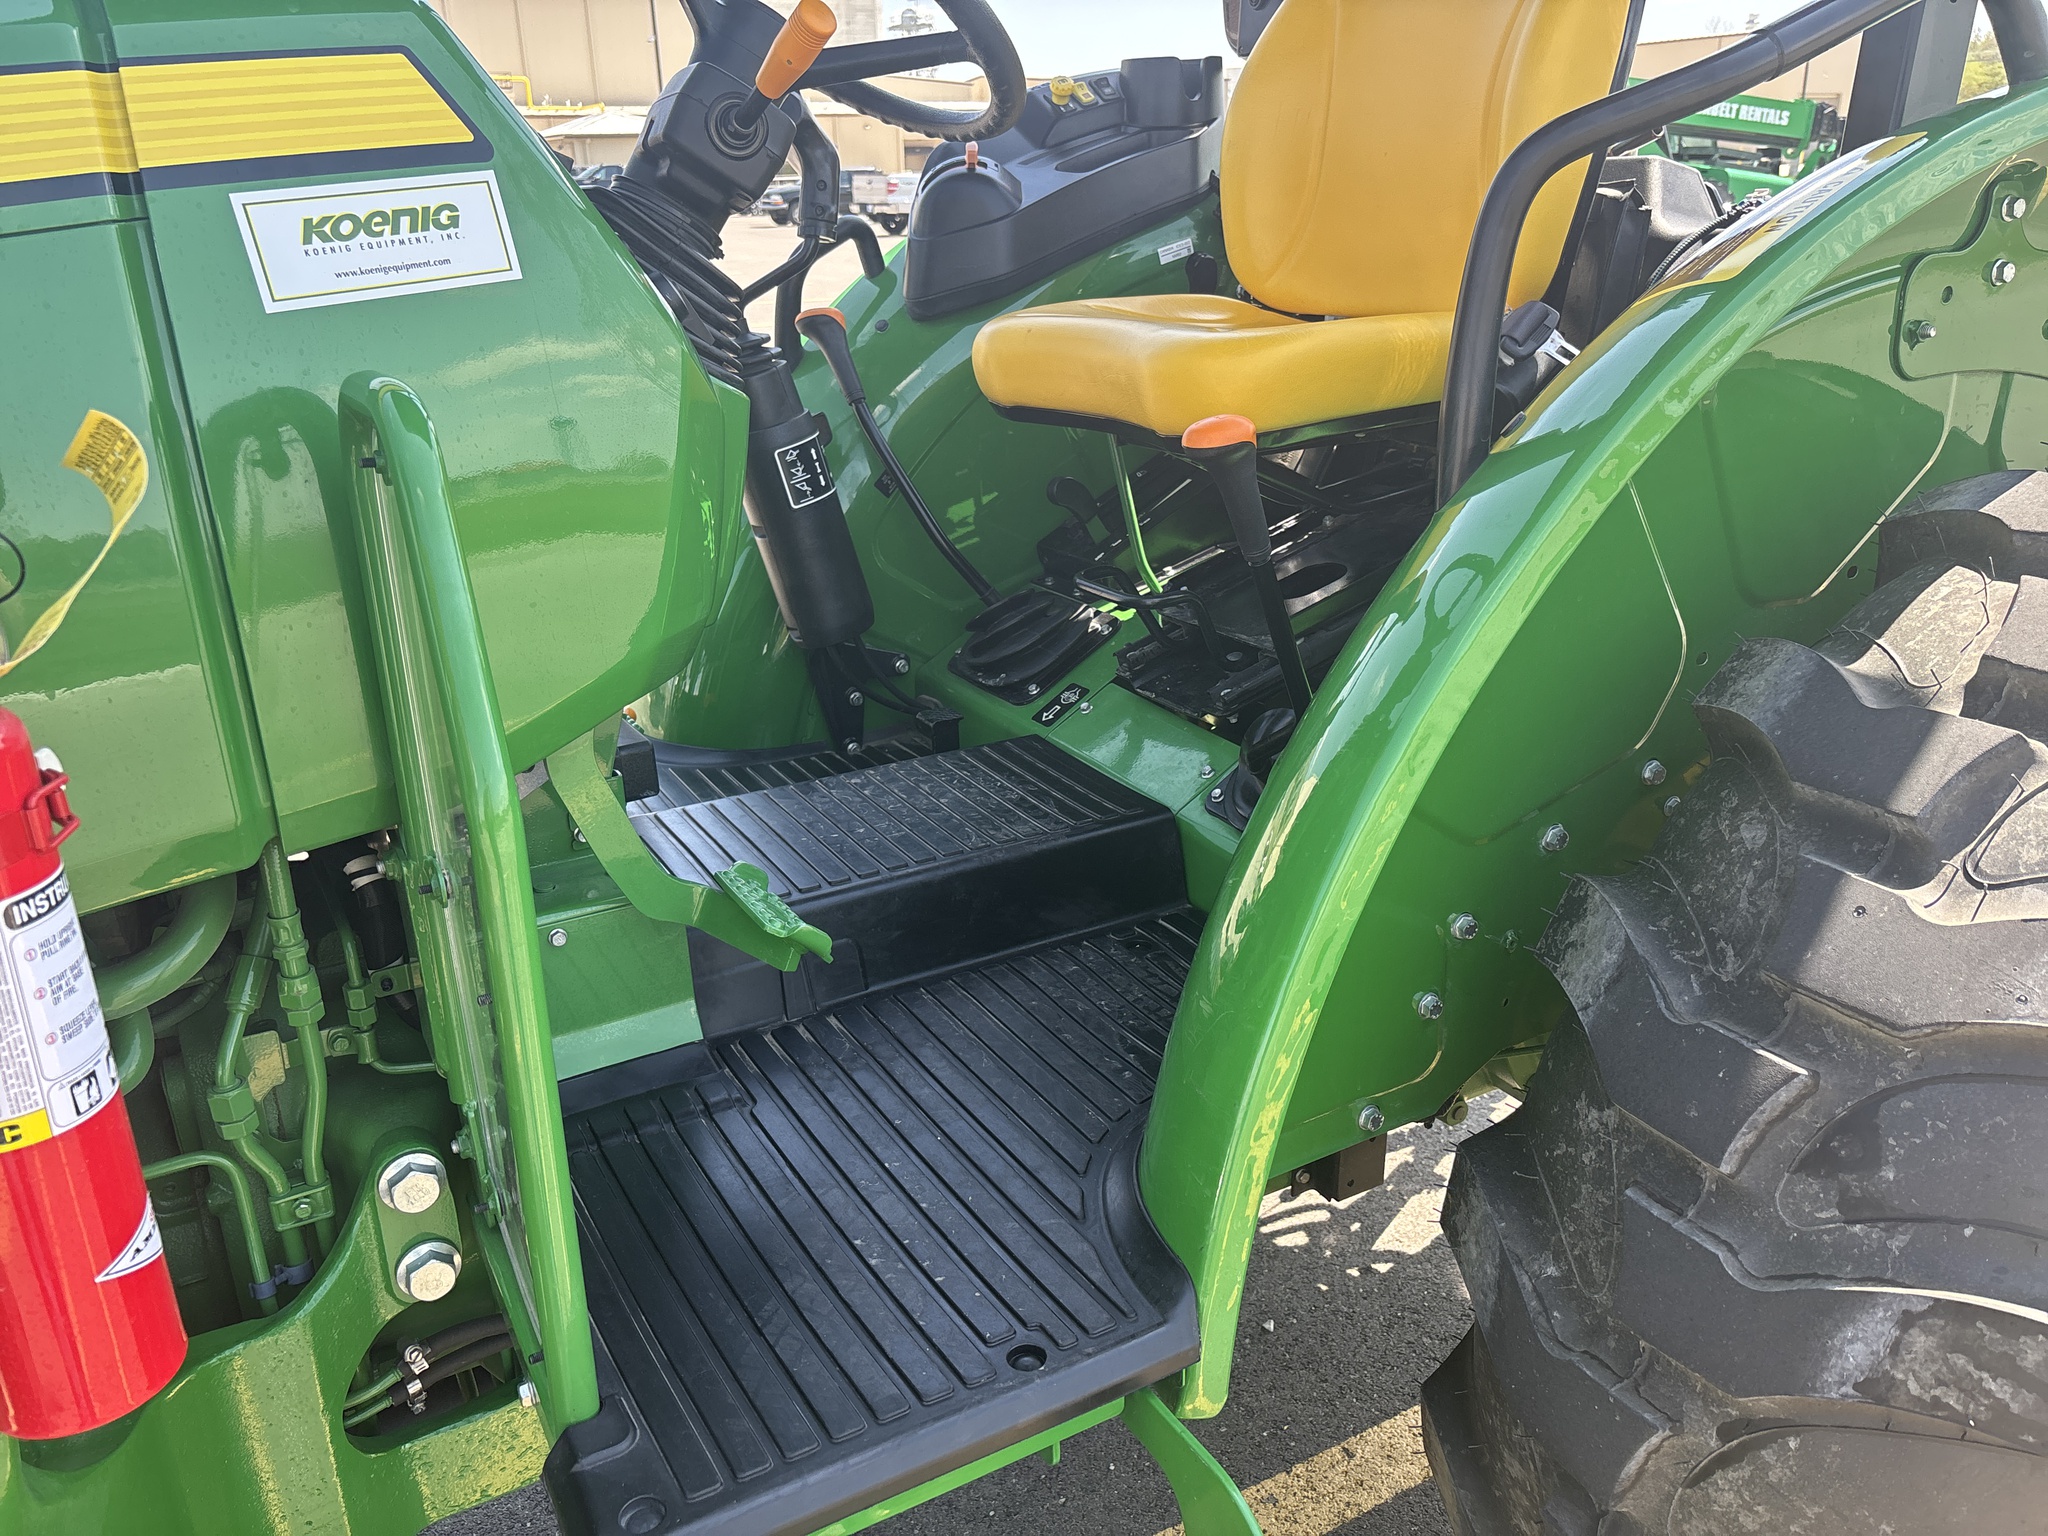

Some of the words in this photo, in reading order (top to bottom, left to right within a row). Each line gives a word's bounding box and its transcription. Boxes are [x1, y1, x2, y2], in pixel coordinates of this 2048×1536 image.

[1706, 102, 1739, 119] BELT
[1738, 104, 1790, 126] RENTALS
[1763, 180, 1844, 233] CAUTION
[303, 239, 352, 258] KOENIG
[360, 235, 434, 251] EQUIPMENT,
[440, 232, 466, 242] INC.
[334, 257, 452, 279] www.koenigequipment.com
